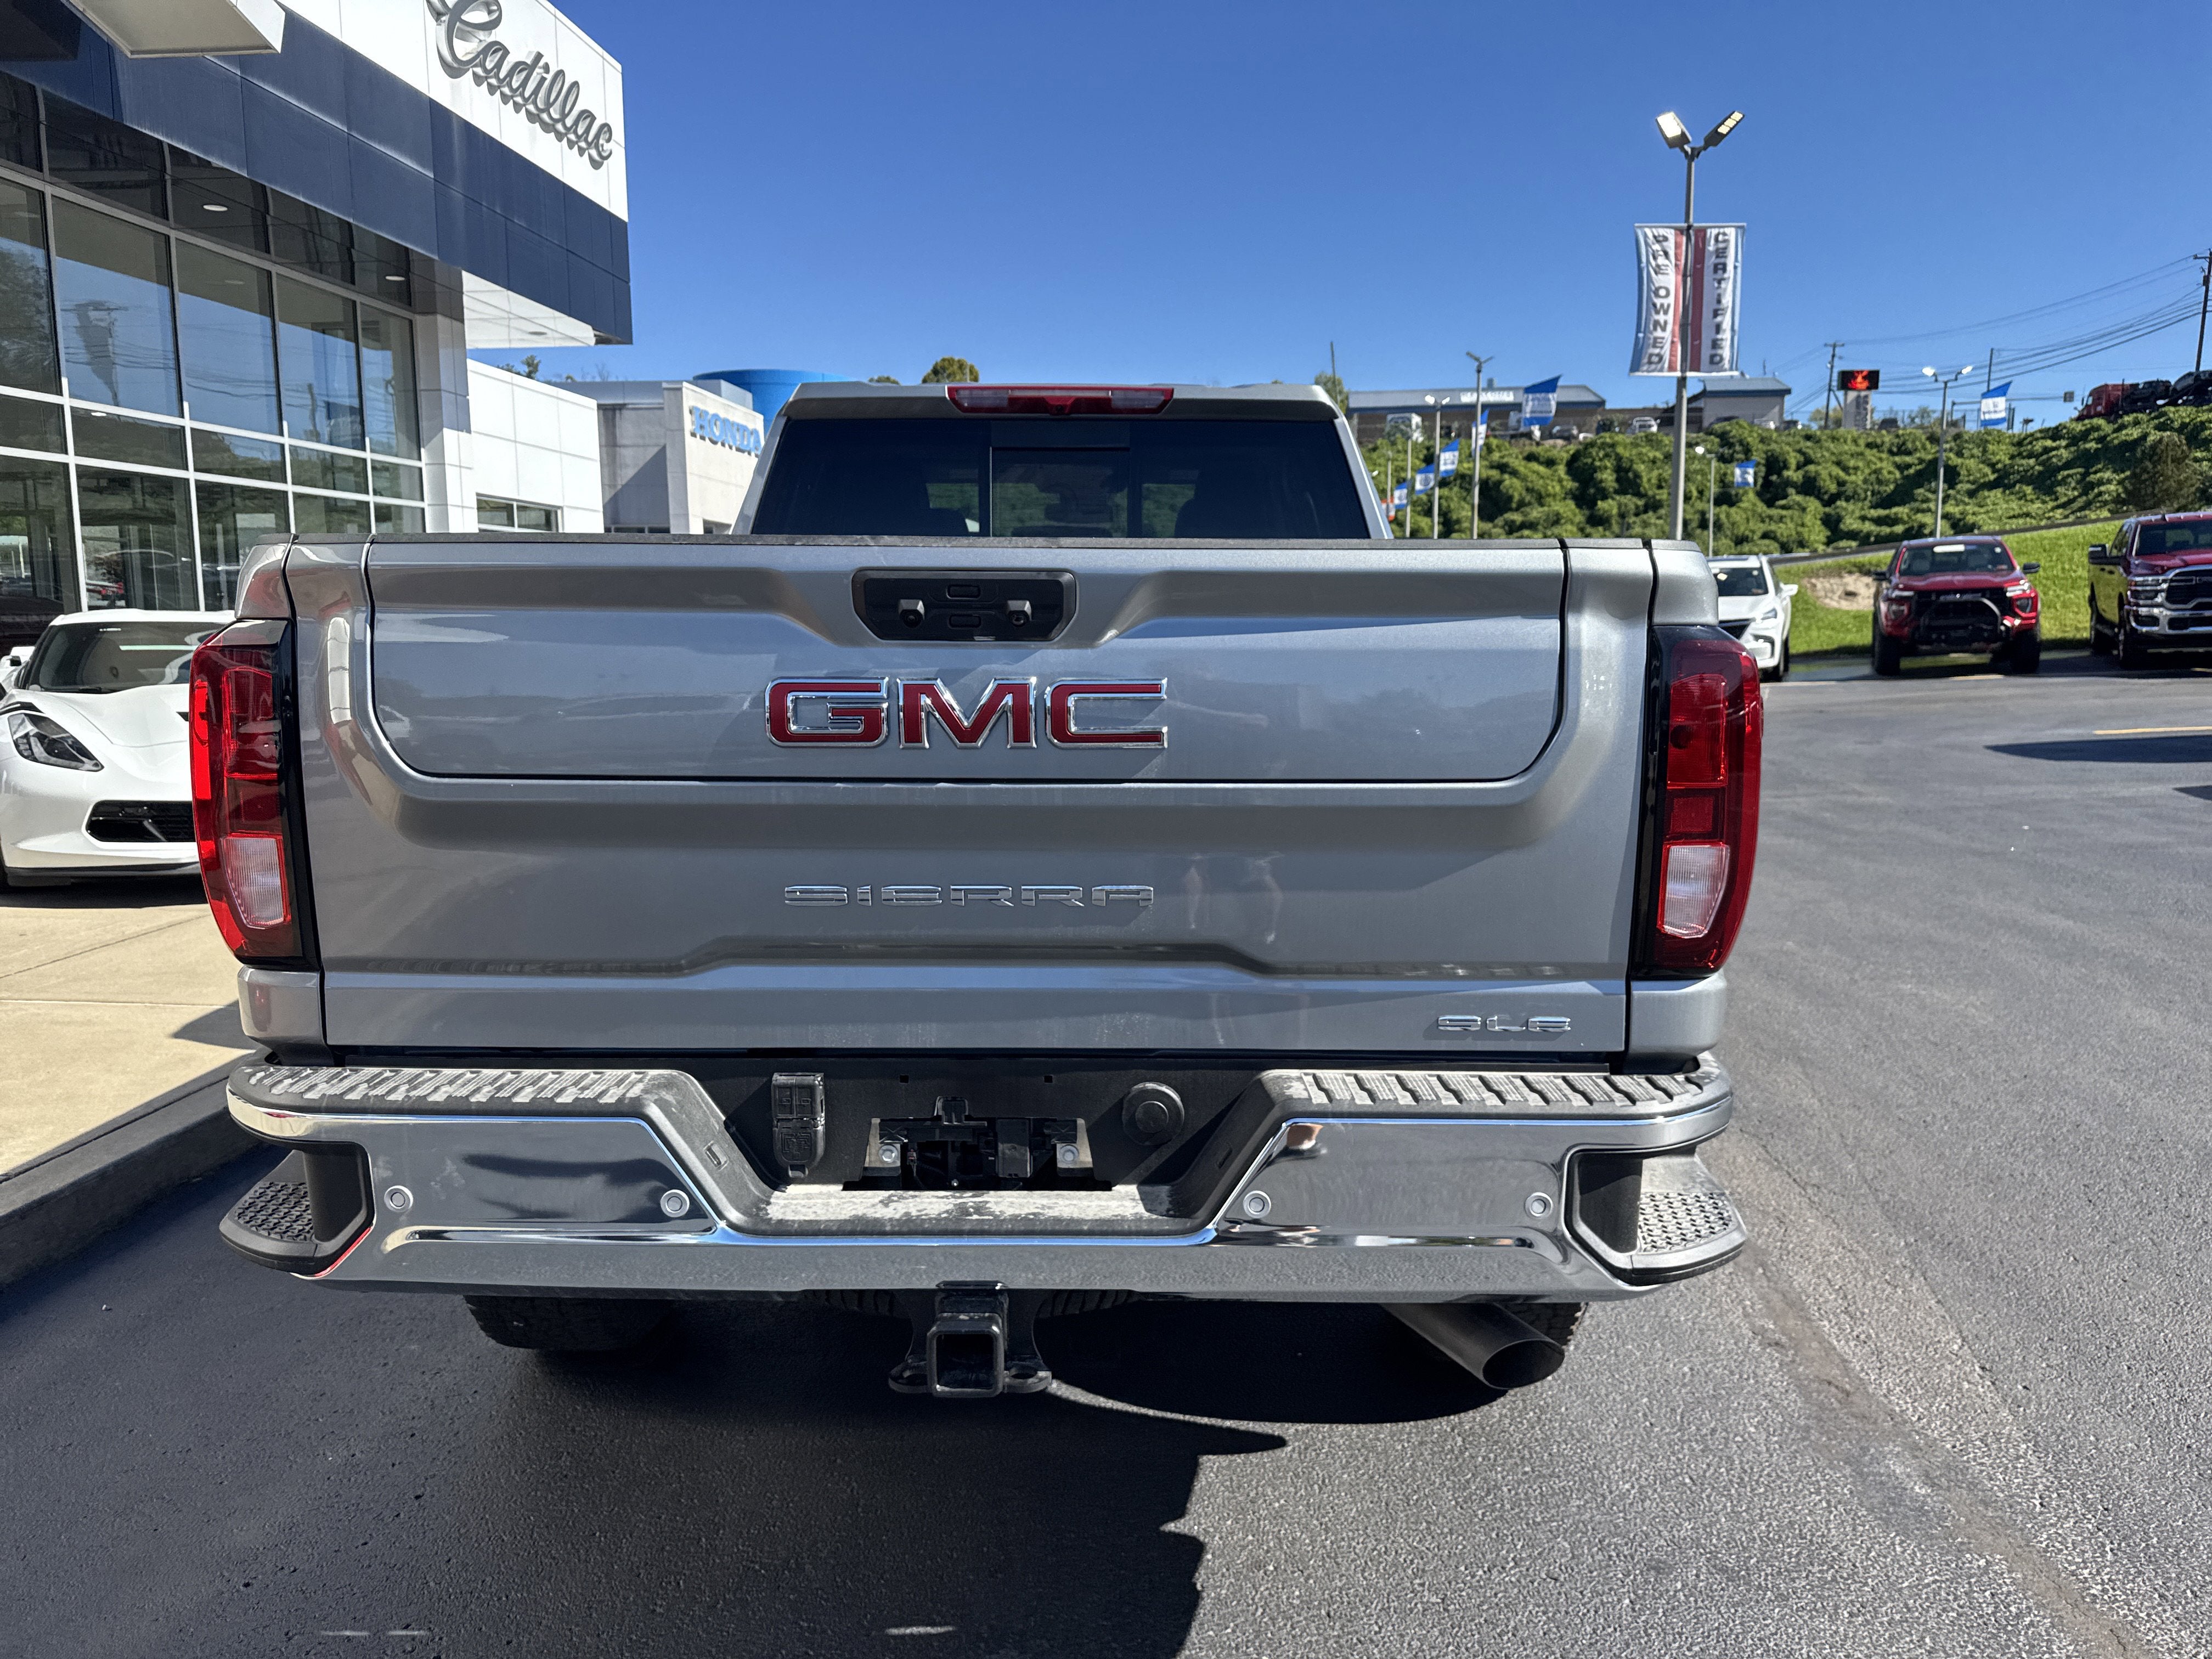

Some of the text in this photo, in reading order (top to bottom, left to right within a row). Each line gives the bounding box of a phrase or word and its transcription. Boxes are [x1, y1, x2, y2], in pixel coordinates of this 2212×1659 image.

[430, 0, 612, 166] Cadillac
[1647, 286, 1671, 365] OWNED
[1709, 232, 1729, 365] CERTIFIED
[691, 405, 762, 456] HONDA
[765, 676, 1168, 749] GMC
[785, 885, 1154, 907] SIERRA
[1437, 1015, 1571, 1032] SLE
